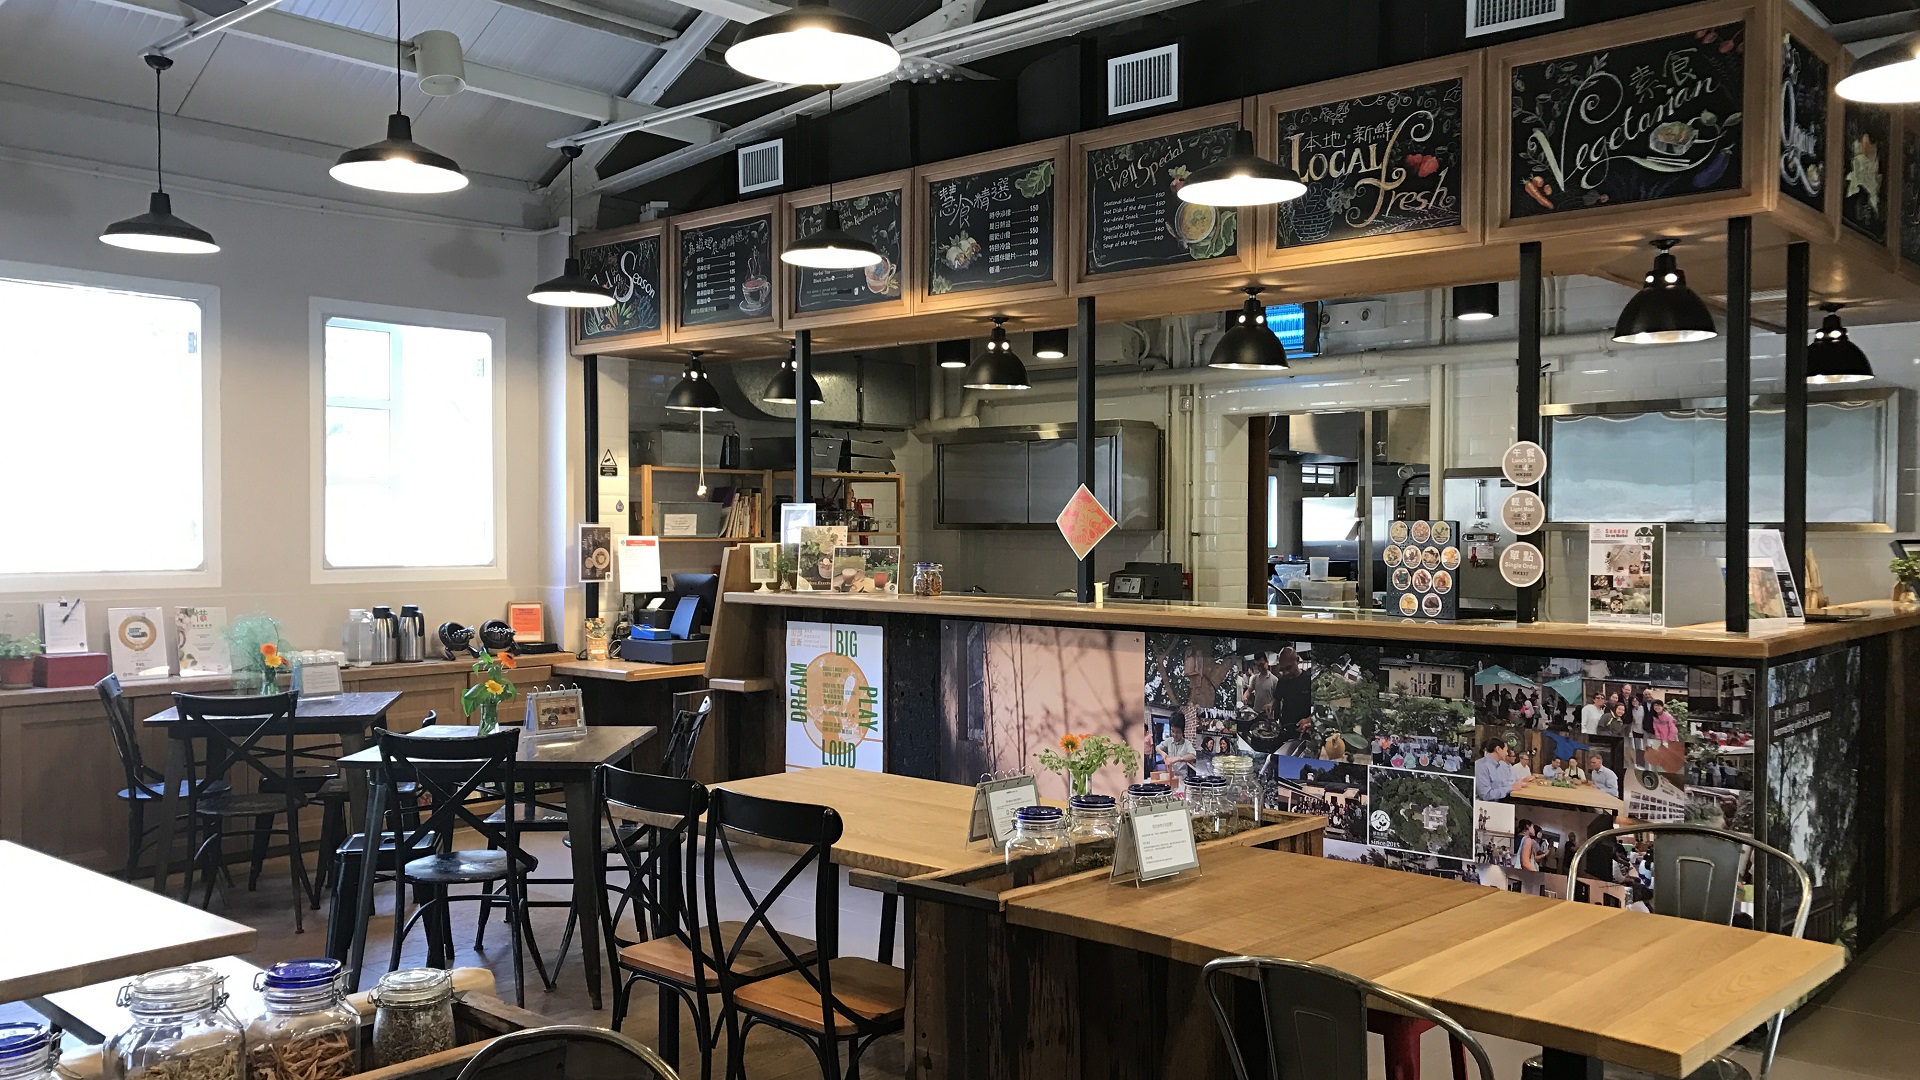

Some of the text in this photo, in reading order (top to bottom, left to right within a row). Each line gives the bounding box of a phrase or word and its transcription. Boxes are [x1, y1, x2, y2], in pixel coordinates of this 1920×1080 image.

[1629, 48, 1698, 104] 素食
[1527, 69, 1721, 192] Vegetarian
[1093, 154, 1119, 180] Eat
[1108, 138, 1187, 192] Well Special
[613, 250, 656, 302] Season
[1512, 448, 1536, 458] 午餐
[1504, 561, 1539, 571] Single Order
[1509, 550, 1534, 562] 單點
[836, 629, 858, 658] BIG
[789, 663, 808, 723] DREAM
[858, 686, 878, 732] PLAY
[821, 739, 857, 769] LOUD
